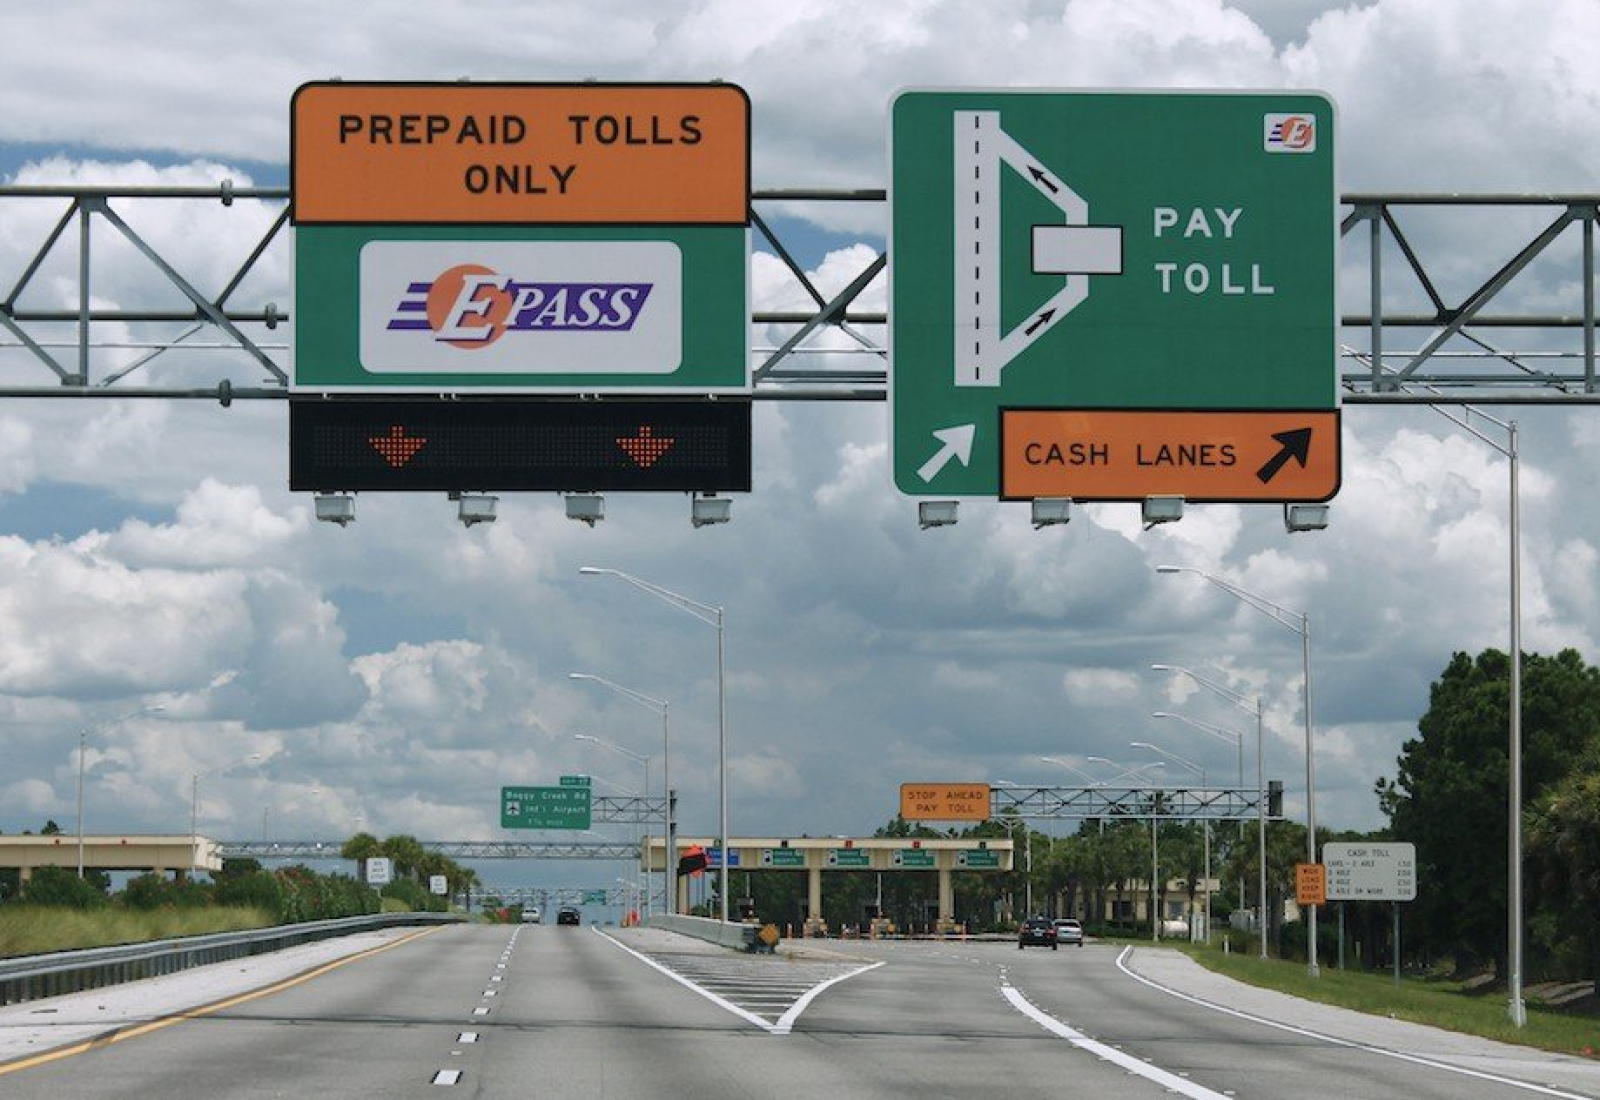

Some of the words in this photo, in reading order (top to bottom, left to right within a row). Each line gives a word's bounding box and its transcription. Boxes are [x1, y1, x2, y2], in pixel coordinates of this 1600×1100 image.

[339, 115, 527, 145] PREPAID
[568, 115, 703, 145] TOLLS
[463, 164, 577, 195] ONLY
[1153, 207, 1245, 238] PAY
[1154, 263, 1275, 295] TOLL
[1024, 443, 1109, 467] CASH
[1136, 444, 1237, 467] LANES
[541, 791, 567, 800] Creek
[908, 791, 936, 800] STOP
[946, 791, 983, 800] AHEAD
[553, 805, 586, 814] Airport
[916, 803, 937, 812] PAY
[948, 803, 975, 813] TOLL
[1347, 848, 1368, 857] CASH
[1372, 848, 1390, 857] TOLL
